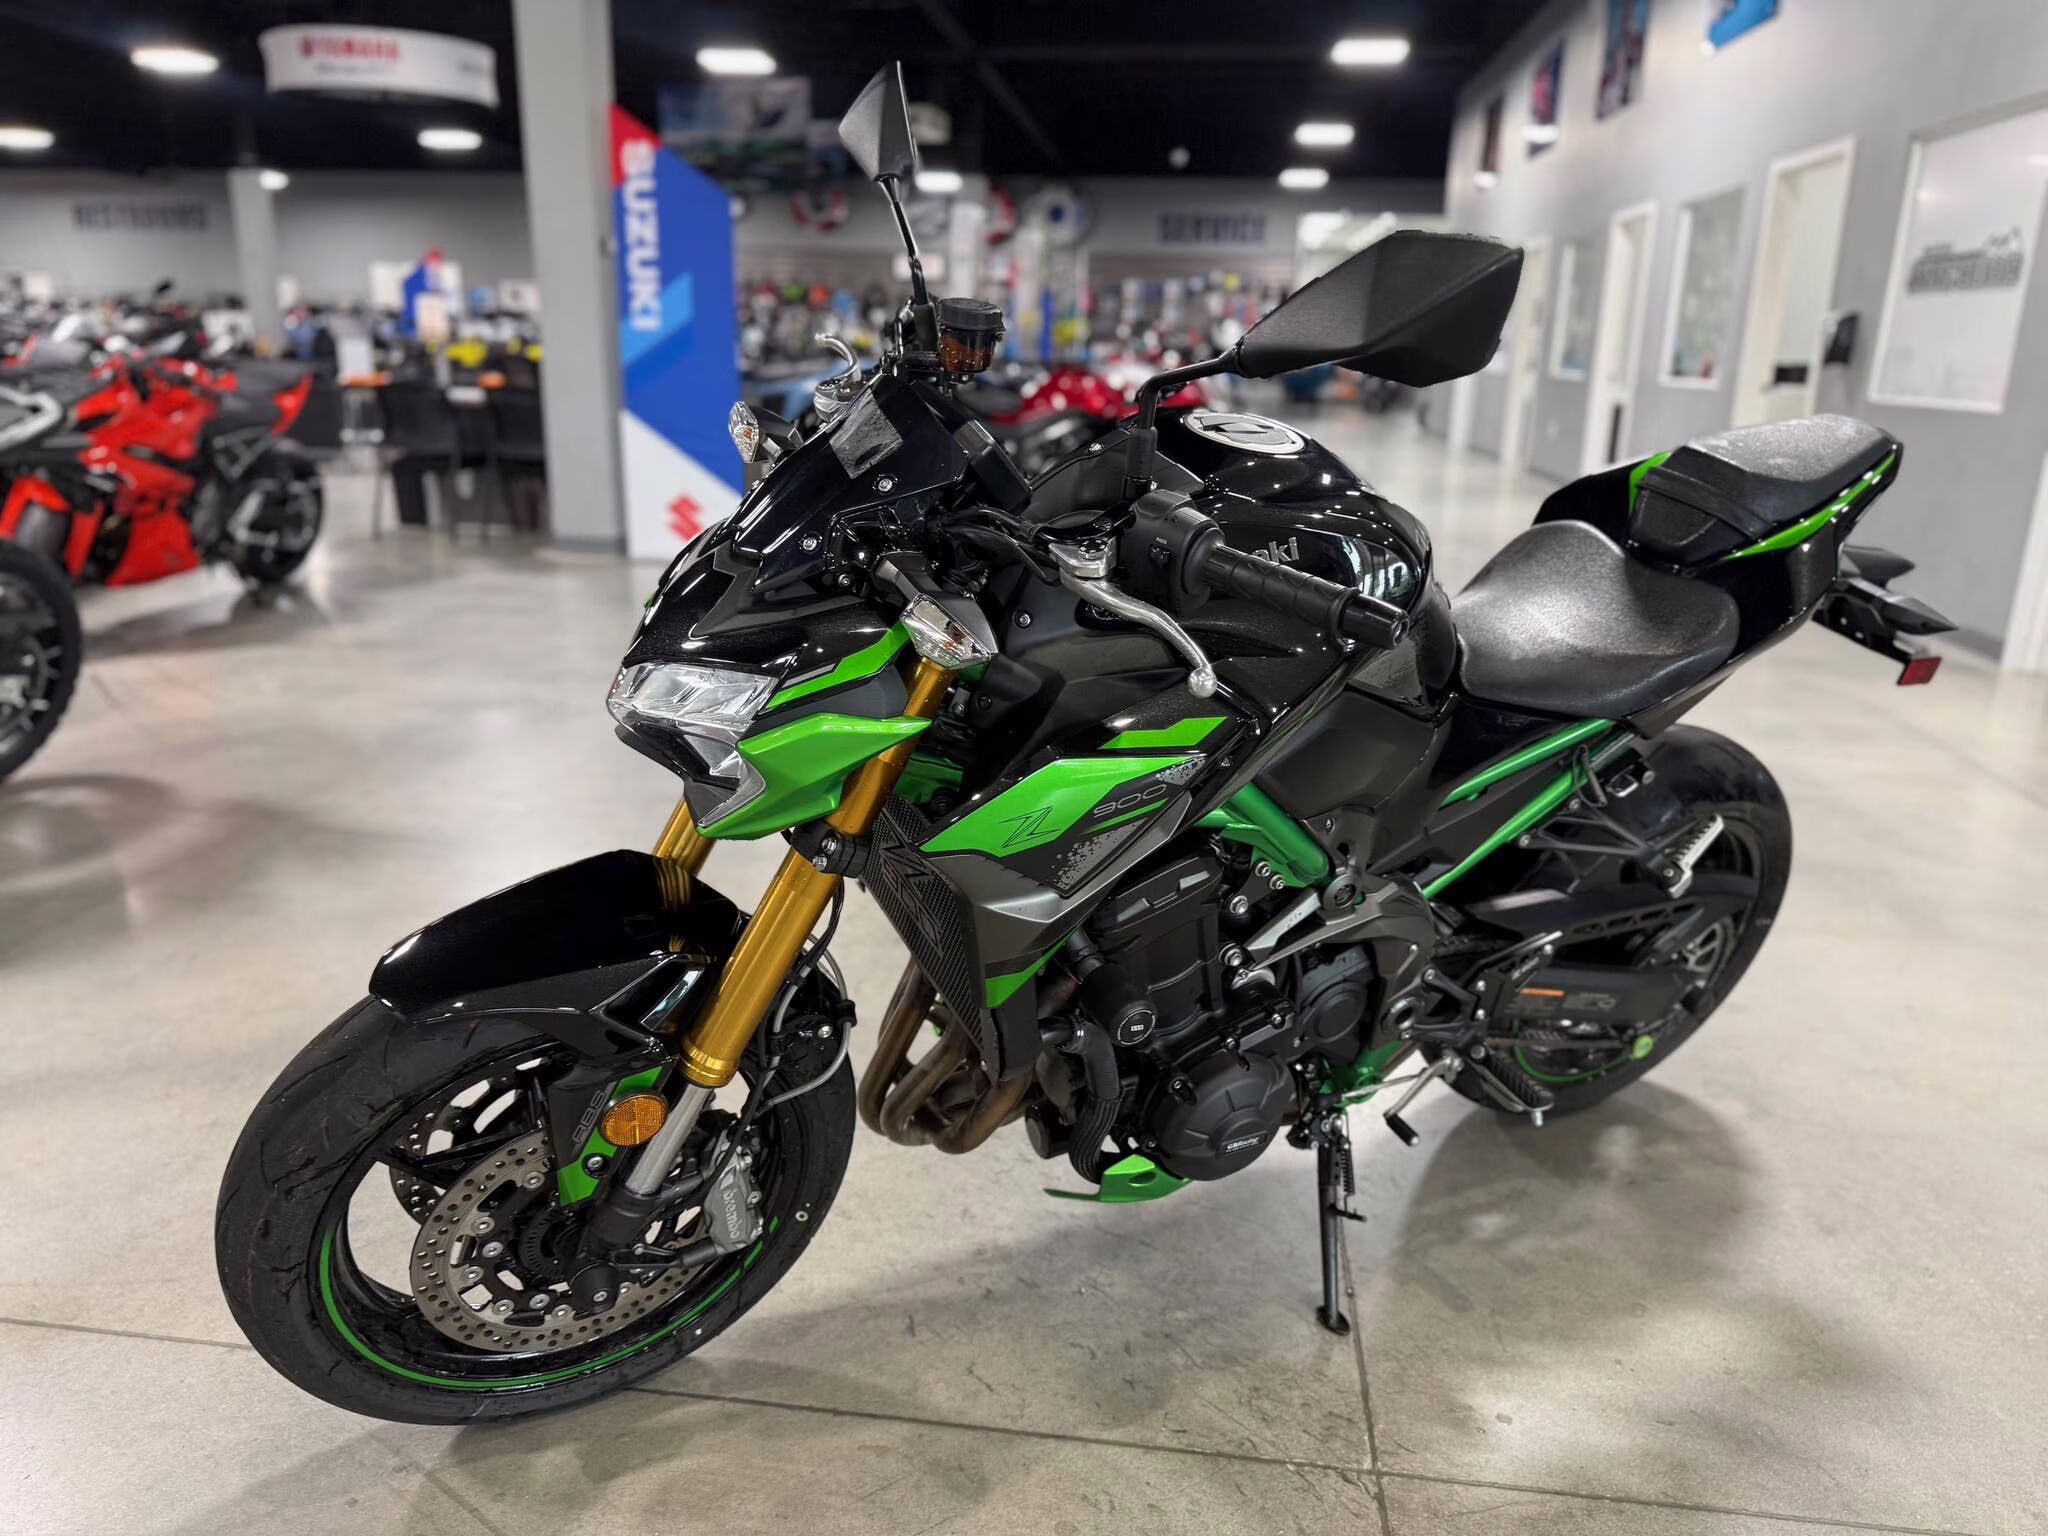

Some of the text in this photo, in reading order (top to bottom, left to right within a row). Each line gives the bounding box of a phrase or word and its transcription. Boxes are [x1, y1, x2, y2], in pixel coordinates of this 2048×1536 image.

[619, 138, 663, 331] SUZUKI
[1093, 784, 1168, 818] 900
[999, 805, 1063, 849] Z
[571, 1090, 605, 1143] ABS
[723, 1188, 743, 1239] brembo
